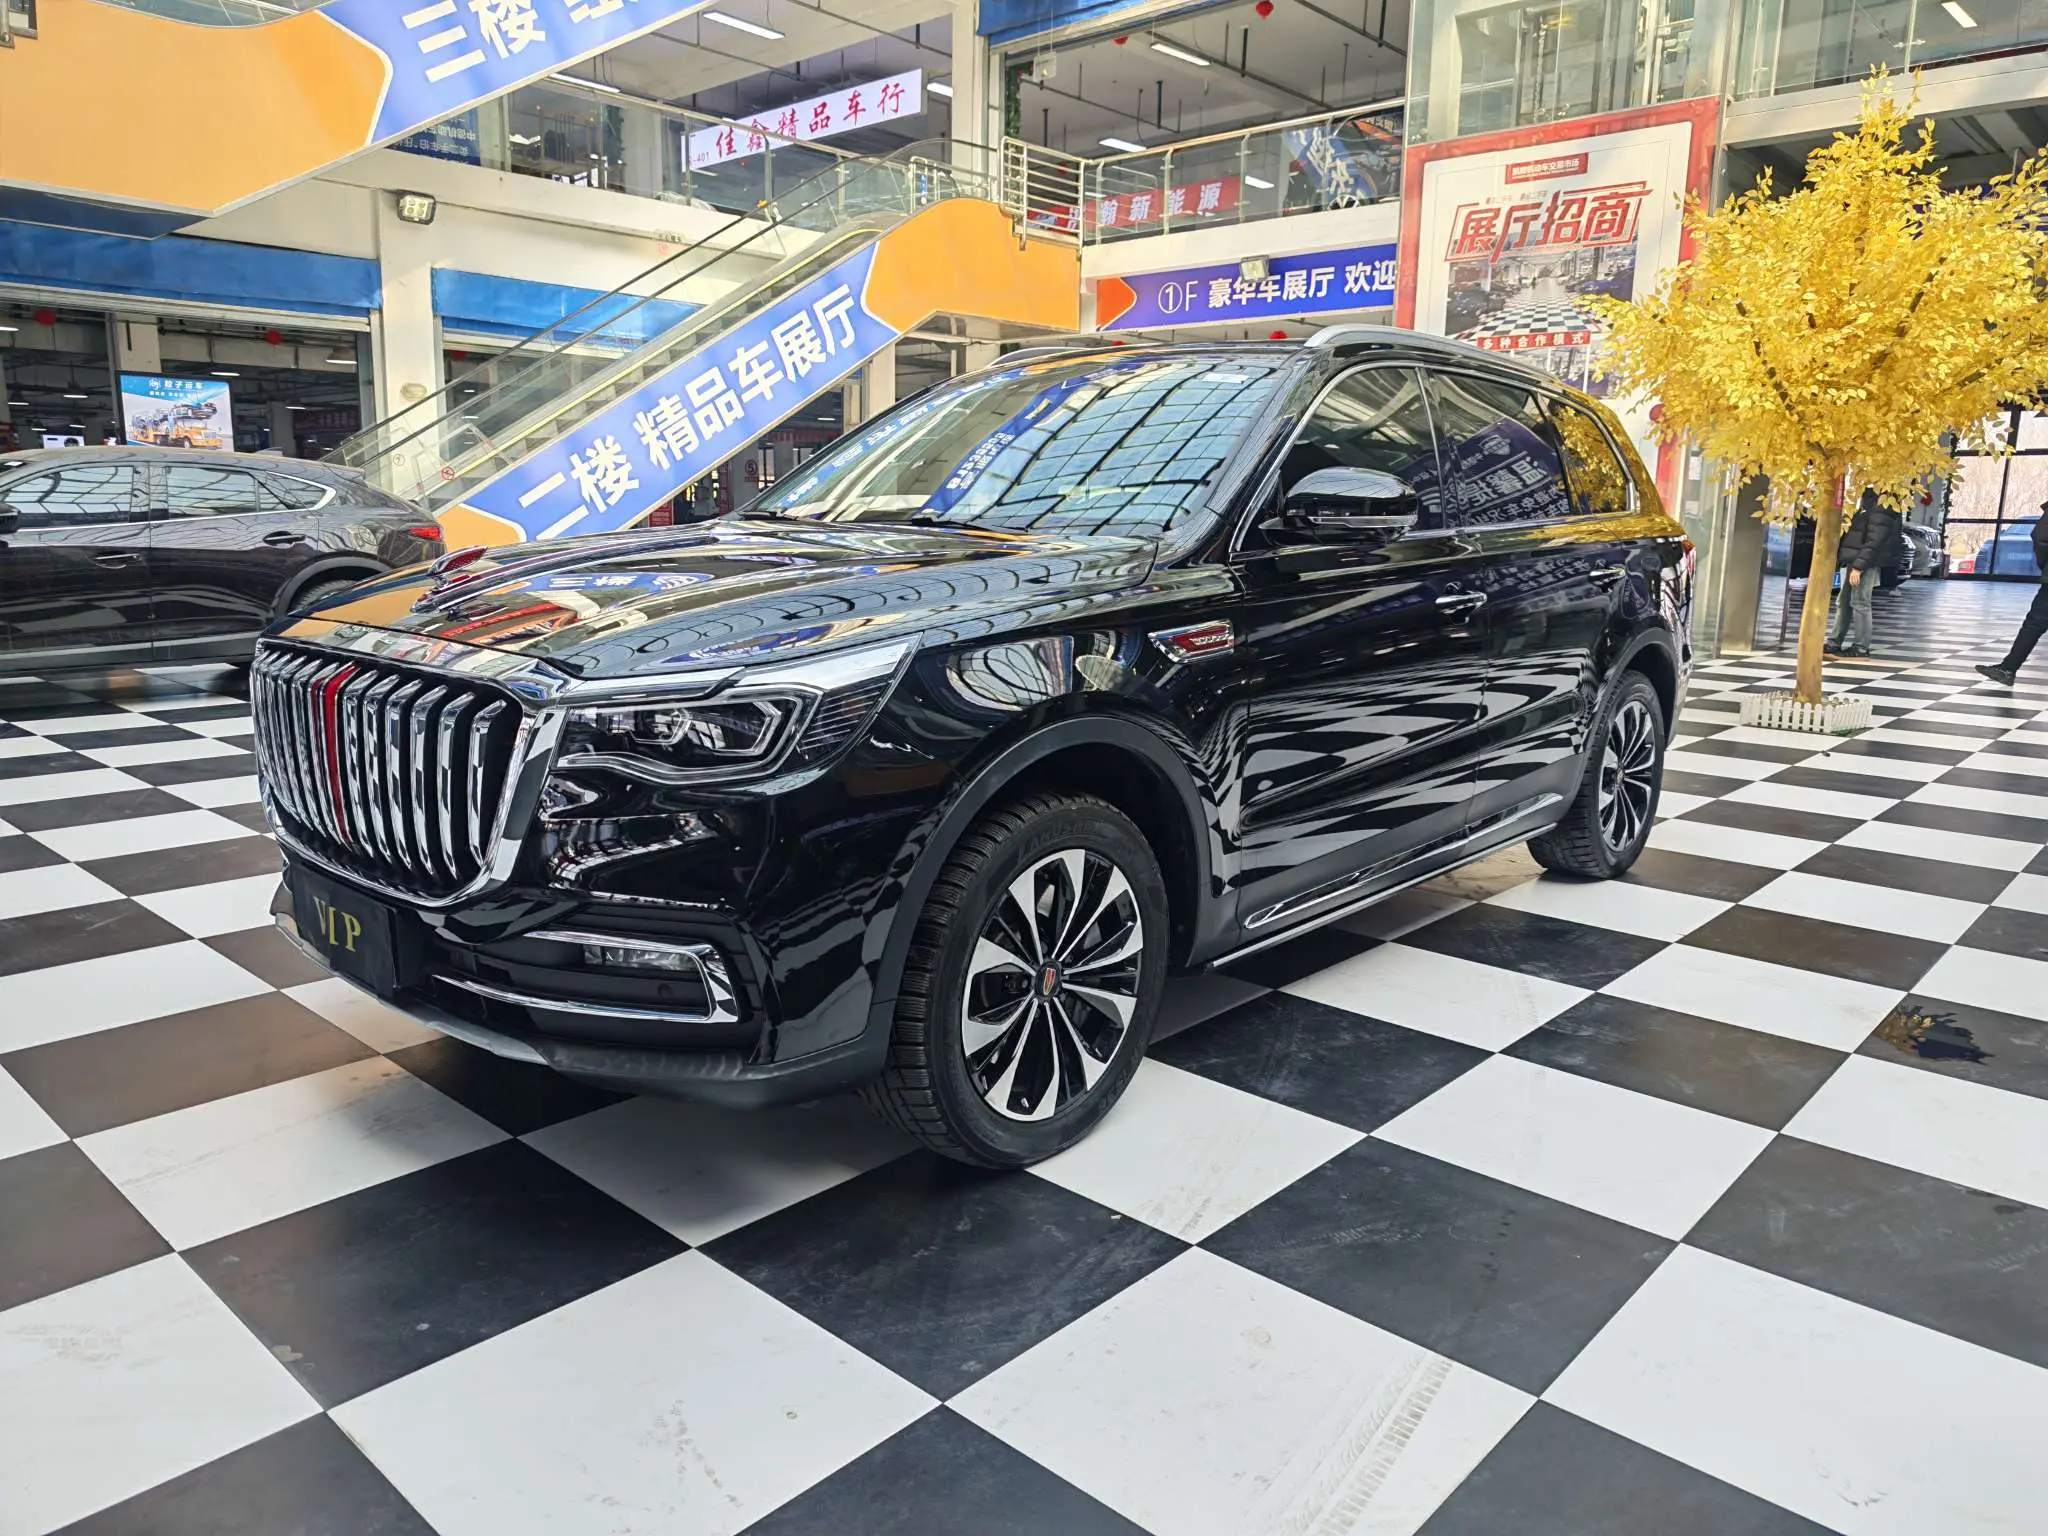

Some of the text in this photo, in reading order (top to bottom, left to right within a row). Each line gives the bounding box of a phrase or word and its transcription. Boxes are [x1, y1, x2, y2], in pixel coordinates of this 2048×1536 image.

[1456, 189, 1654, 265] 展厅招商
[1208, 267, 1335, 308] 豪华车展厅
[1482, 332, 1584, 350] 多种合作模式
[518, 435, 640, 541] 二楼
[633, 284, 856, 471] 精品车展厅
[313, 895, 361, 952] VIP
